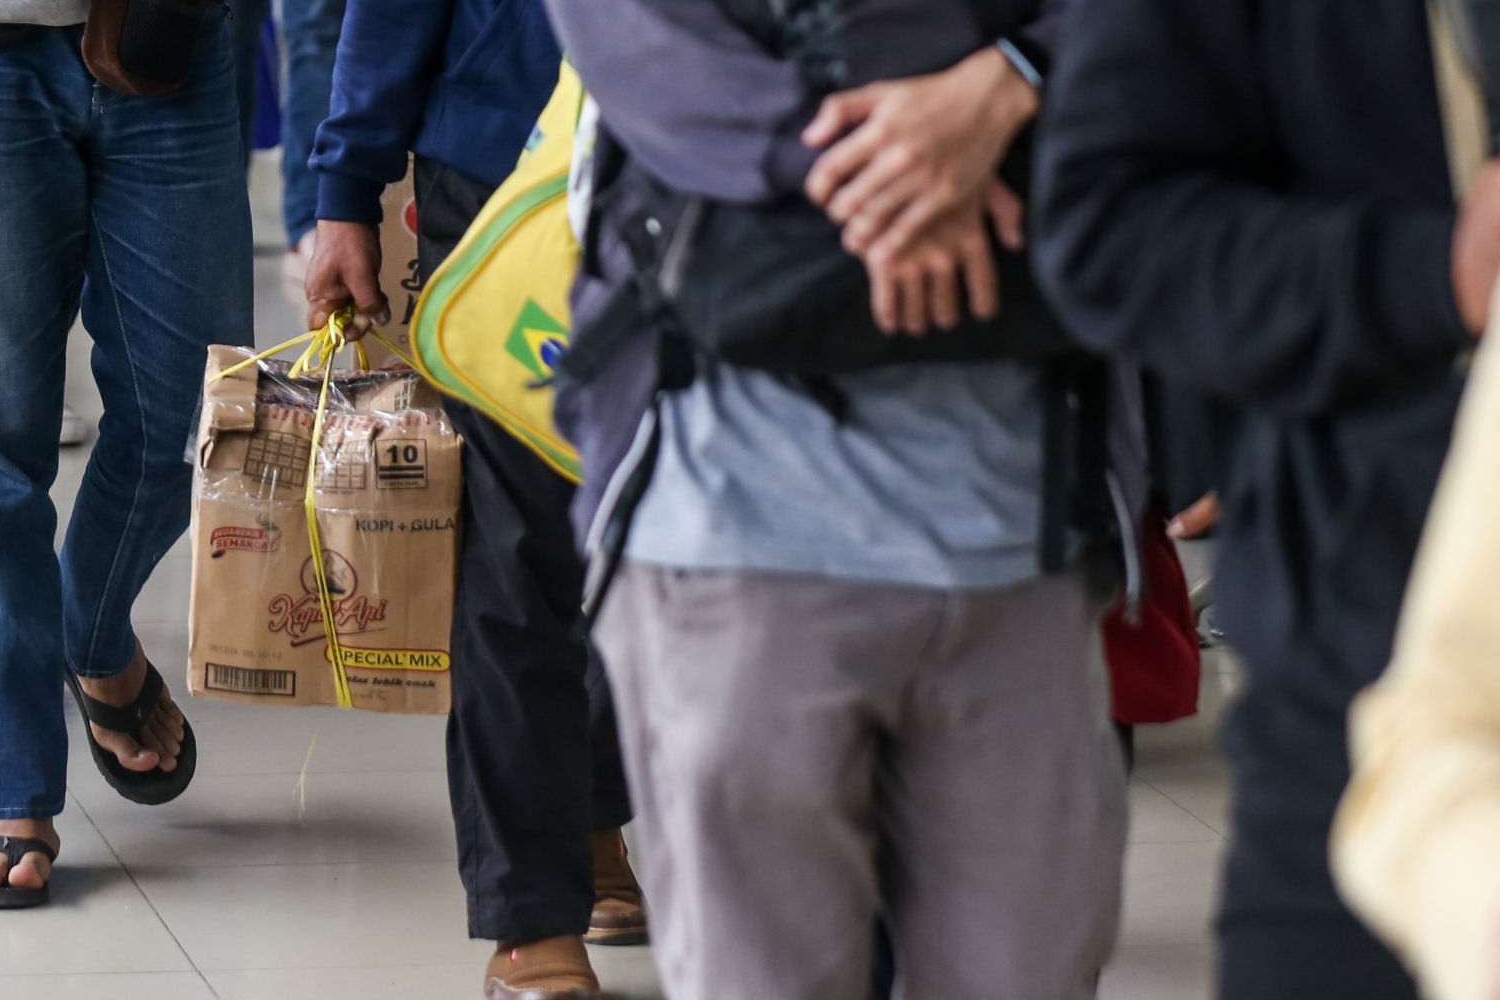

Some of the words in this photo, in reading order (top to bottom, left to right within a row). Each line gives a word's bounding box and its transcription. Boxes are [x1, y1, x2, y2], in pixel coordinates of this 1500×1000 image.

[386, 444, 418, 463] 10
[356, 519, 393, 531] KOPI
[411, 517, 455, 532] GULA
[409, 653, 442, 667] MIX
